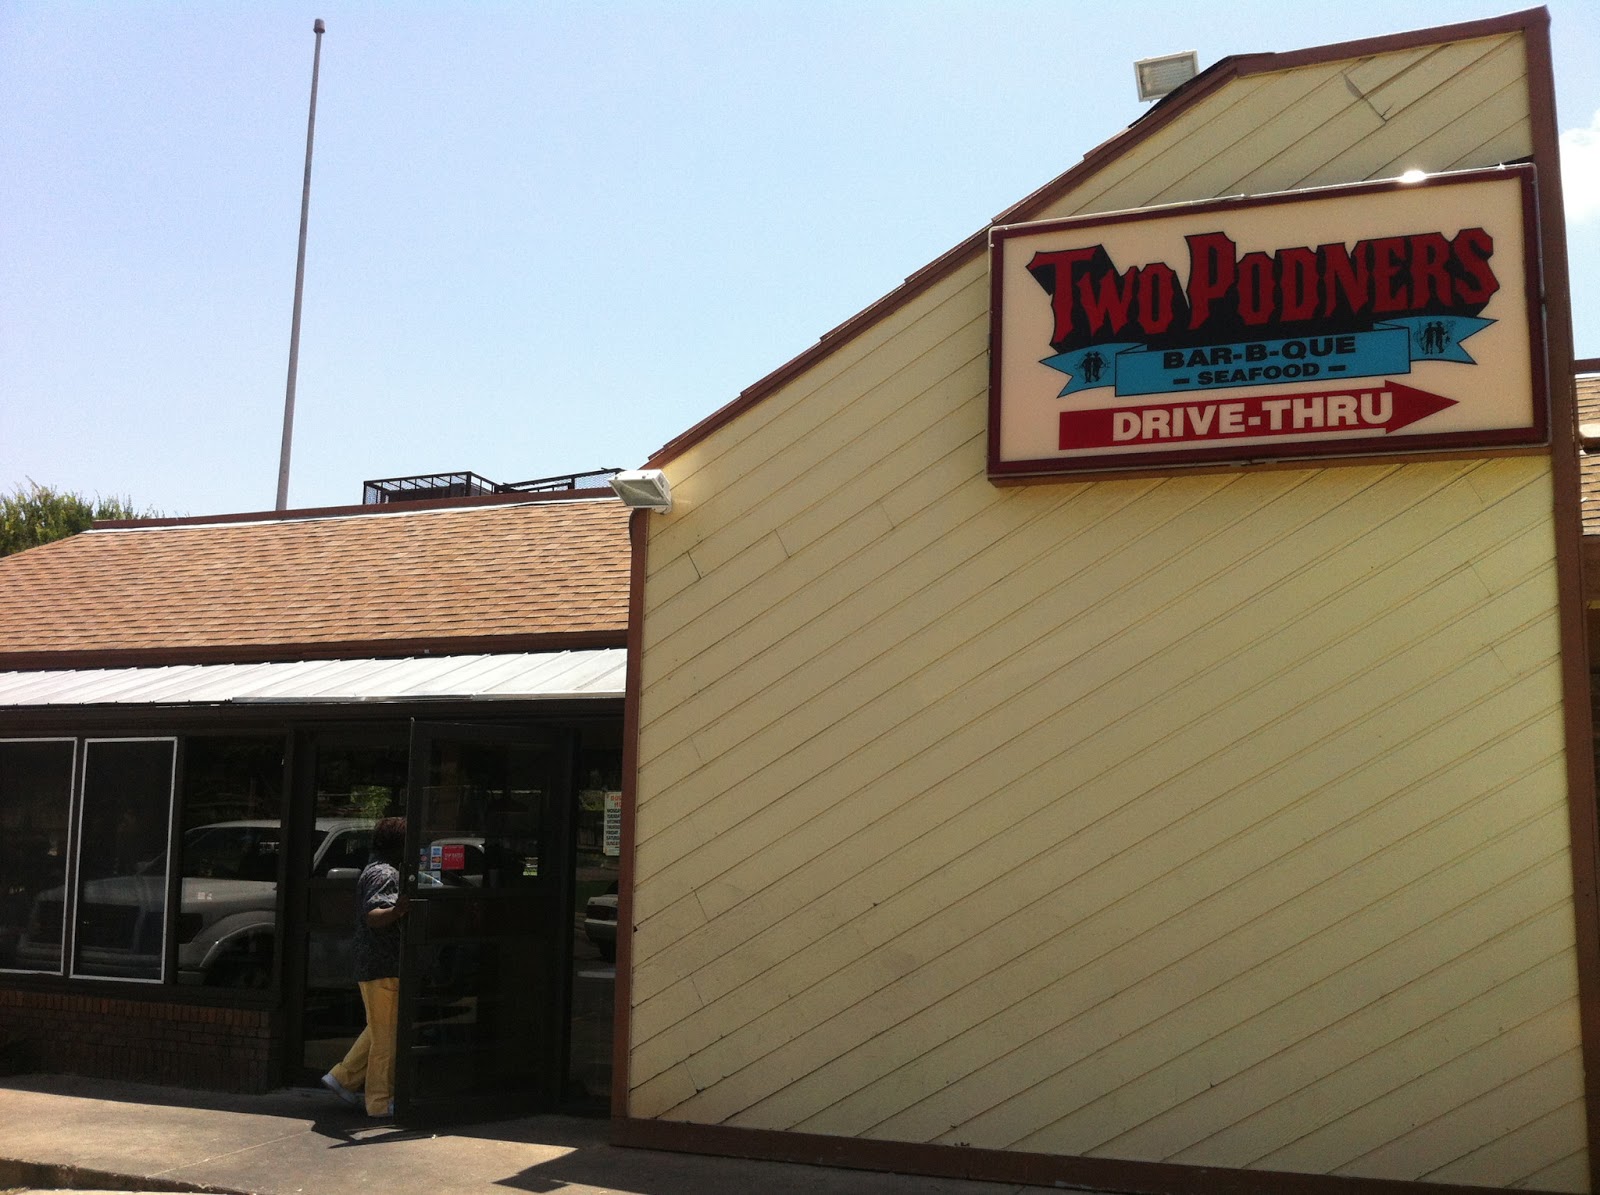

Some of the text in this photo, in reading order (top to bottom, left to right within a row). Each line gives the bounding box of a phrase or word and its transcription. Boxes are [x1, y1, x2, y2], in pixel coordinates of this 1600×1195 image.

[1184, 228, 1500, 331] PODNERS
[1163, 336, 1356, 370] BAR-B-QUE
[1197, 362, 1320, 386] SEAFOOD
[1112, 391, 1394, 442] DRIVE-THRU
